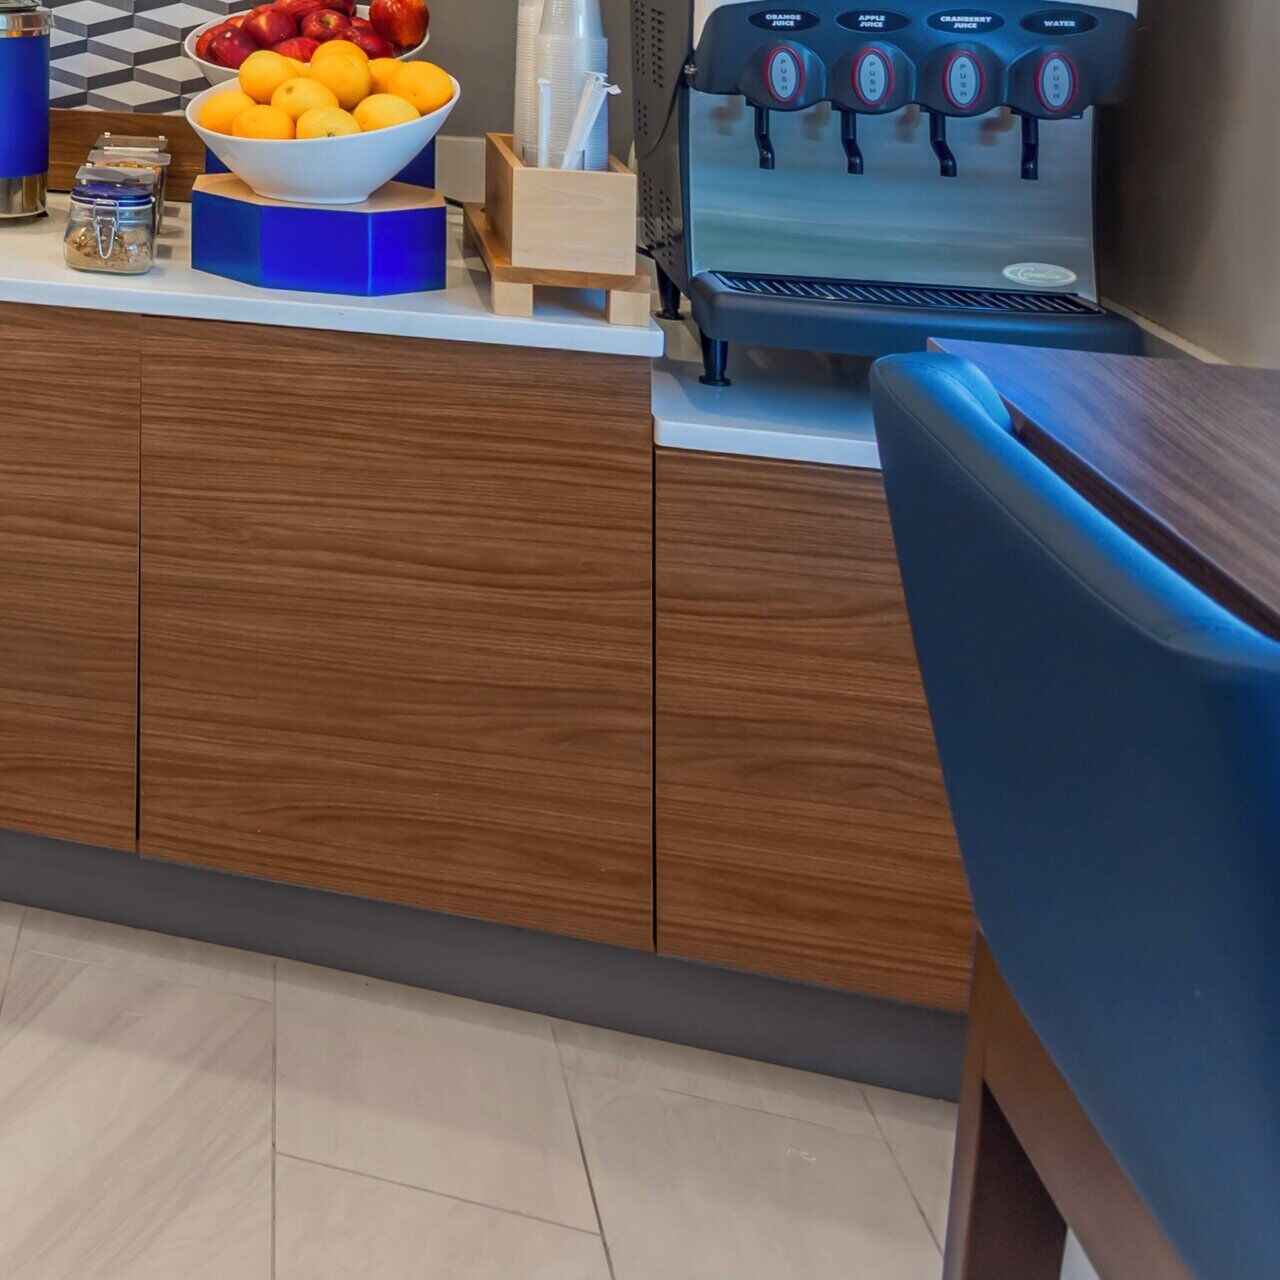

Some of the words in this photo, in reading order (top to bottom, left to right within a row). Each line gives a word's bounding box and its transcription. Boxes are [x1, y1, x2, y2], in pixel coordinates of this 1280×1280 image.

[940, 15, 992, 23] CRANBERRY
[1043, 20, 1076, 28] WATER
[780, 59, 788, 91] PUSH
[869, 61, 877, 94] PUSH
[959, 64, 967, 97] PUSH
[1052, 66, 1060, 99] PUSH
